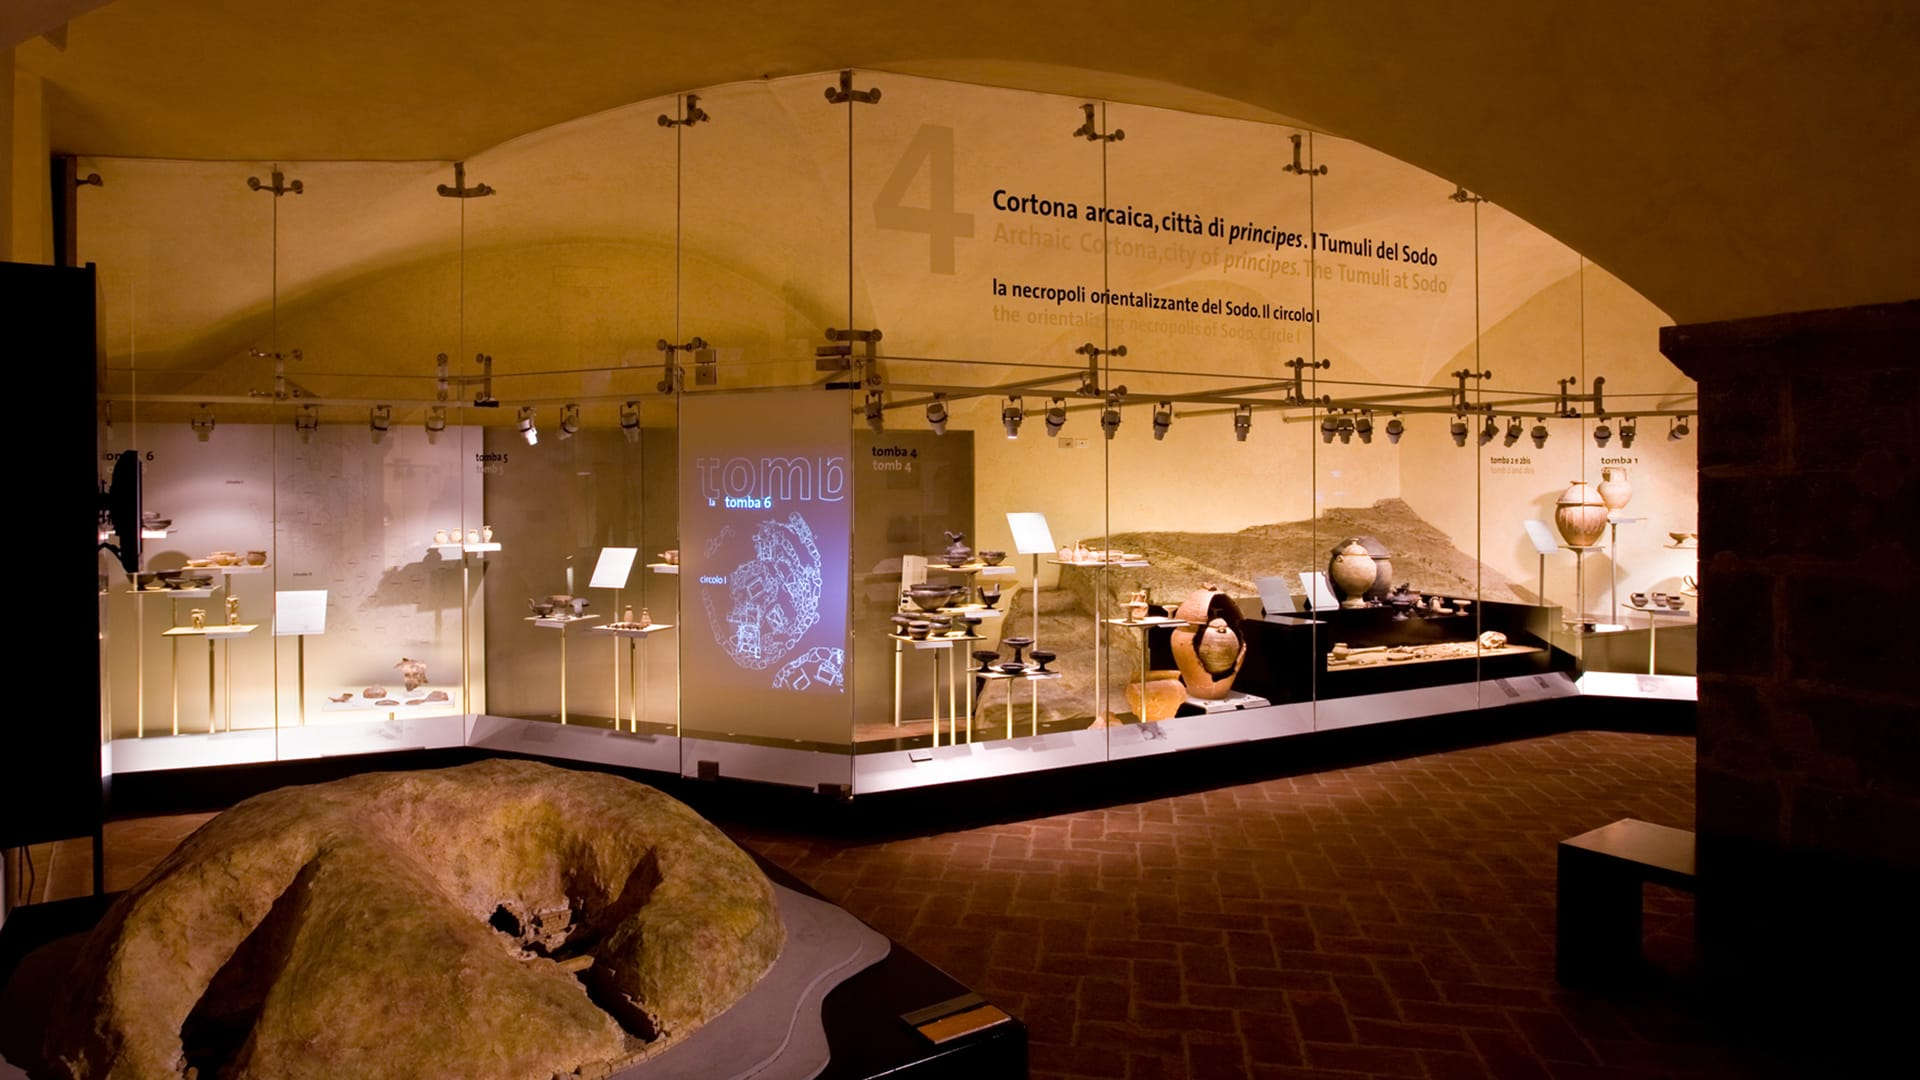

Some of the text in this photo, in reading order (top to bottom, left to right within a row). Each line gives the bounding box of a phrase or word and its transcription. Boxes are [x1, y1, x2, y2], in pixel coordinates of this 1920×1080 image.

[872, 123, 975, 275] 4
[992, 189, 1078, 219] Cortona
[1085, 205, 1159, 233] arcaica,
[1162, 211, 1203, 235] città
[1208, 217, 1225, 238] di
[1228, 221, 1308, 250] principes.
[1319, 233, 1372, 257] Tumuli
[1376, 240, 1399, 261] del
[1402, 245, 1438, 266] Sodo
[993, 222, 1072, 250] Archaic
[1163, 243, 1195, 269] city
[1200, 245, 1219, 266] of
[1223, 247, 1300, 278] principes.
[1305, 258, 1333, 280] The
[1338, 263, 1390, 287] Tumuli
[1393, 271, 1409, 289] at
[1412, 273, 1447, 294] Sodo
[992, 278, 1007, 296] la
[1012, 284, 1085, 305] necropoli
[1090, 288, 1199, 312] orientalizzante
[1202, 298, 1222, 314] del
[1226, 301, 1261, 318] Sodo.
[1273, 305, 1314, 323] circolo
[992, 304, 1020, 322] the
[1204, 322, 1218, 337] of
[1259, 327, 1294, 342] Circle
[146, 451, 154, 461] 6
[475, 452, 502, 461] tomba
[872, 446, 918, 459] tomba 4
[872, 459, 912, 472] tomb 4
[1490, 456, 1509, 464] tomba
[1600, 457, 1632, 465] tomba
[724, 495, 761, 509] tomba
[763, 496, 772, 509] 6
[699, 576, 723, 584] circolo
